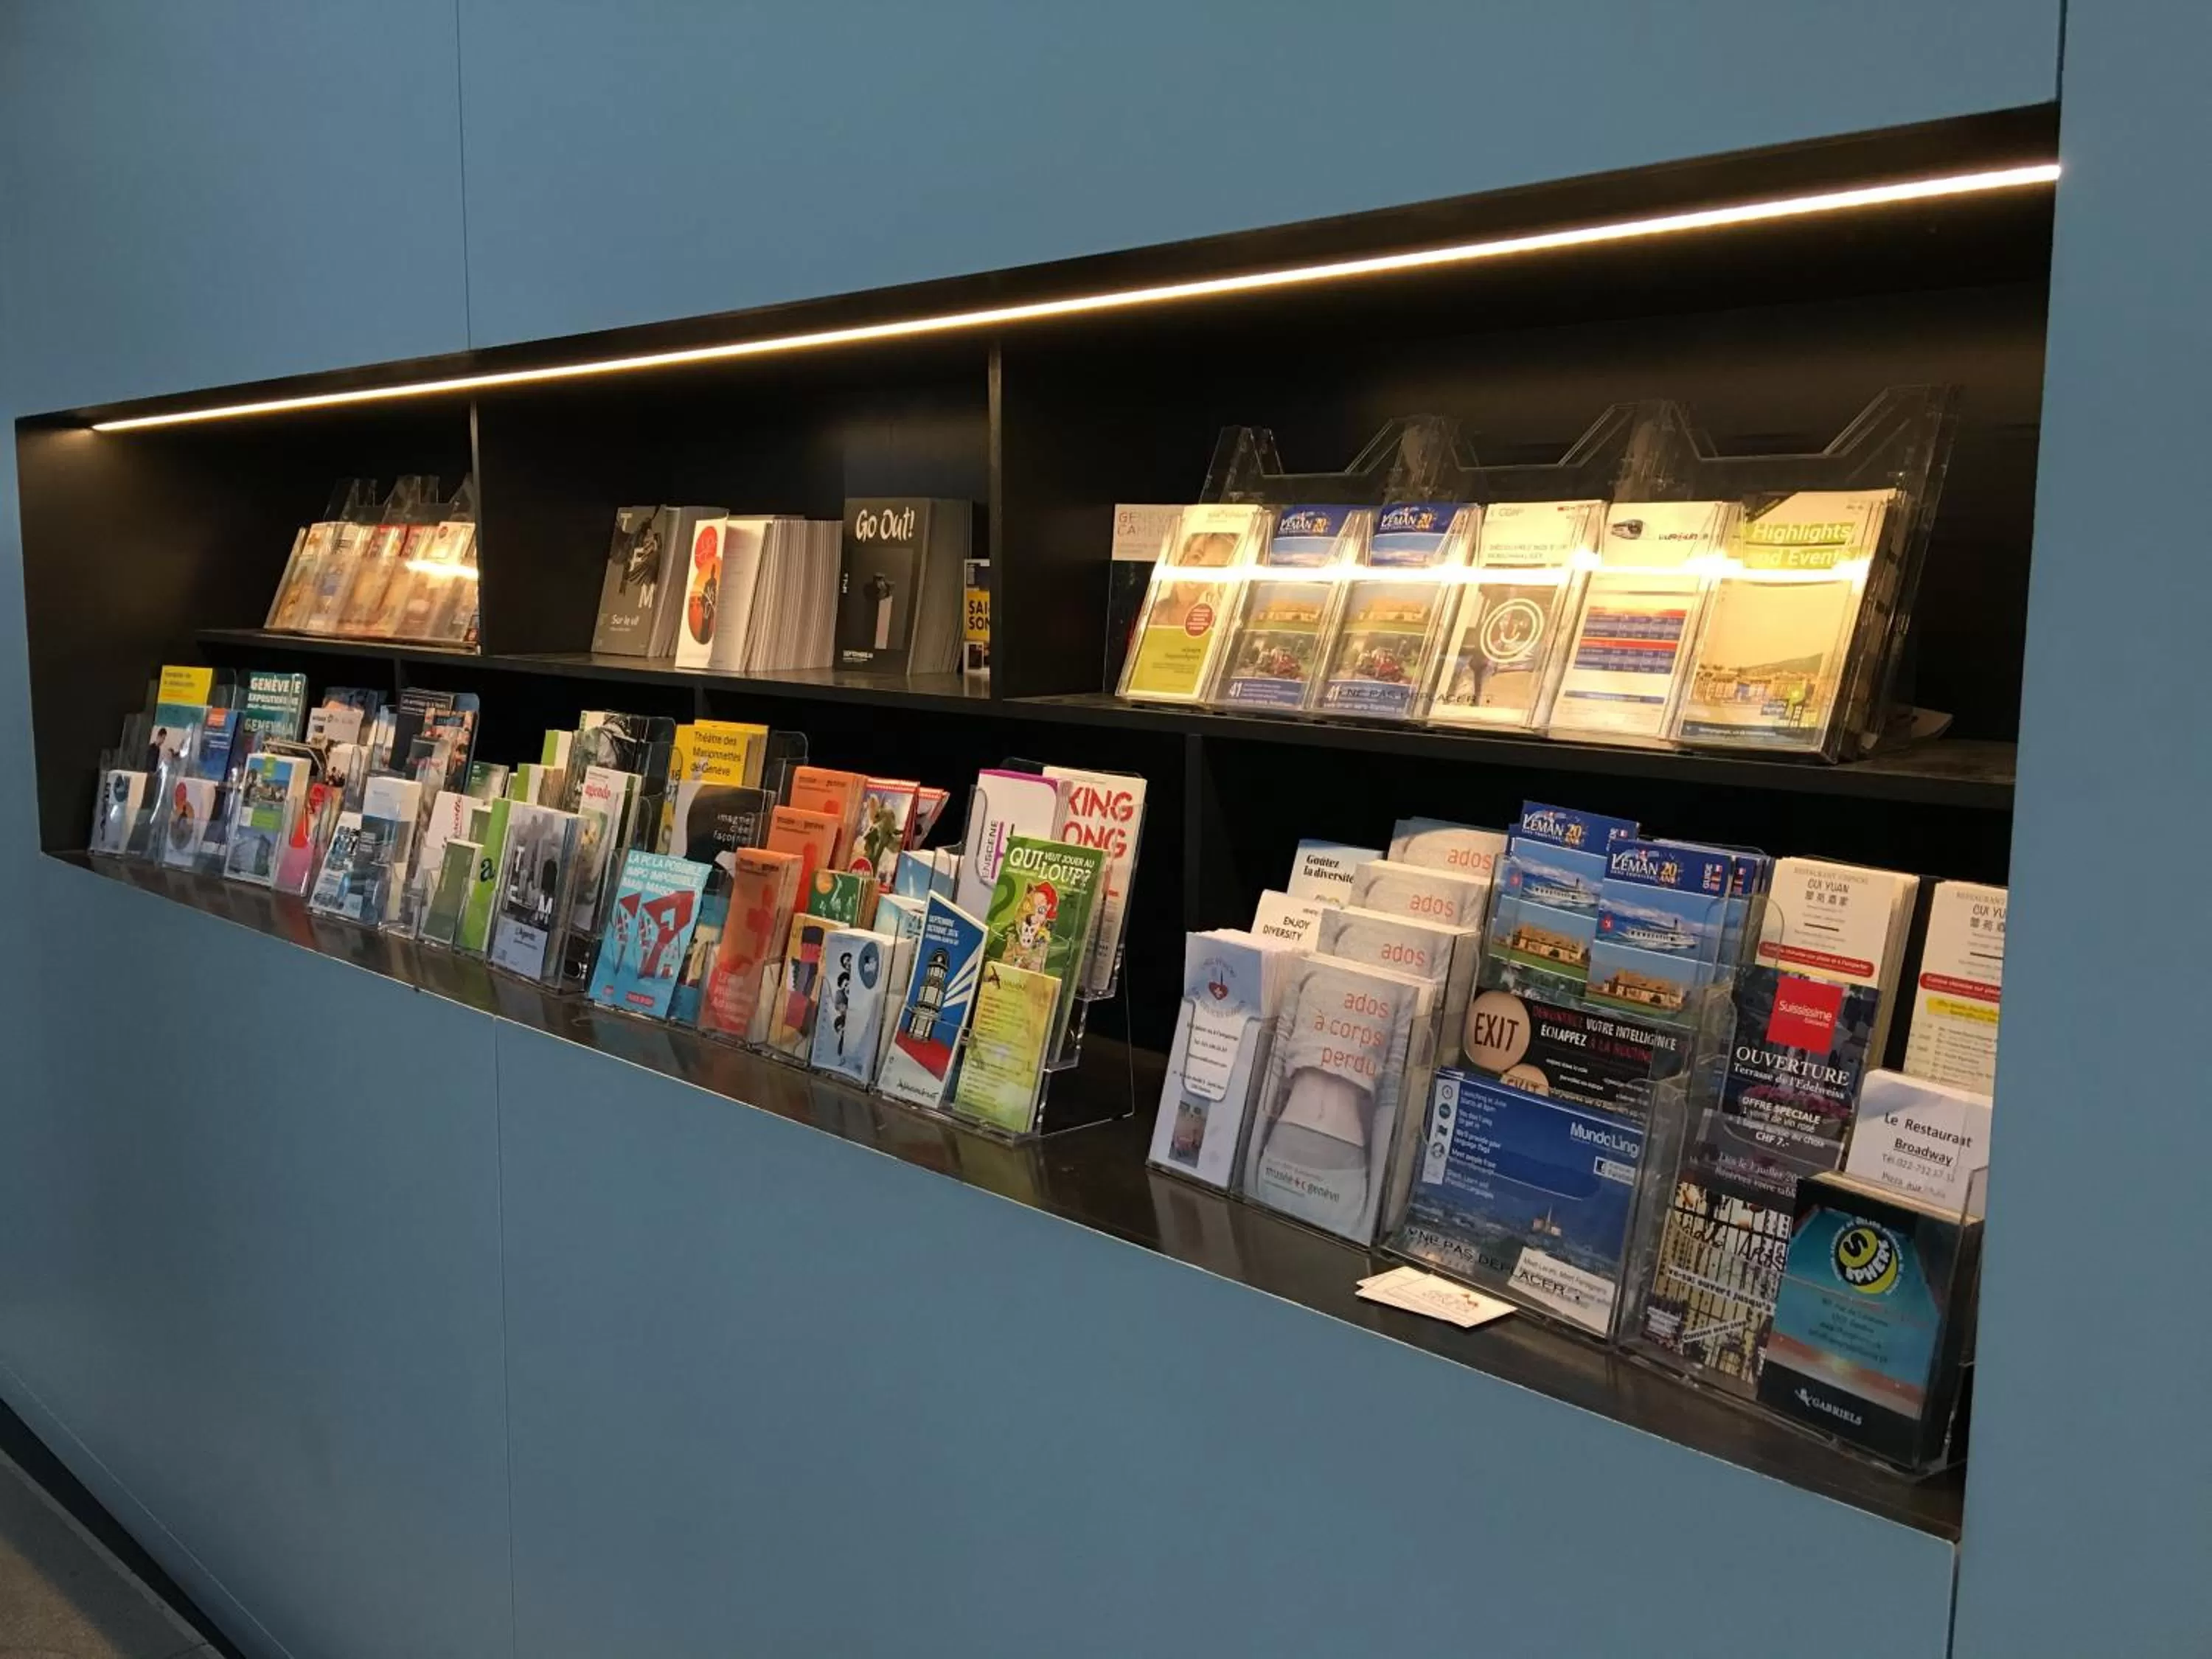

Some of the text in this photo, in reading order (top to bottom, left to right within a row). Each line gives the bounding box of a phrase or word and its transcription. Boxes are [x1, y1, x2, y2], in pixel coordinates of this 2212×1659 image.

[856, 507, 915, 542] Go Out!
[1752, 523, 1851, 543] Highlights
[968, 600, 990, 614] SAI
[1069, 786, 1134, 822] KING
[1062, 821, 1127, 859] ONG
[1009, 846, 1045, 871] QUI
[1303, 865, 1315, 877] la
[1447, 847, 1493, 870] ados
[1038, 860, 1092, 886] LOUP?
[1409, 892, 1455, 917] ados
[1992, 905, 2005, 919] YU
[1262, 924, 1304, 942] DIVERSITY
[1283, 916, 1311, 931] ENJOY
[1380, 942, 1426, 968] ados
[1344, 991, 1390, 1019] ados
[1314, 1009, 1385, 1047] à corps
[1474, 1012, 1520, 1052] EXIT
[1321, 1046, 1377, 1078] perdu
[1733, 1062, 1773, 1082] Terrasse
[1736, 1046, 1851, 1088] OUVERTURE
[1742, 1096, 1773, 1112] OFFRE
[1884, 1112, 1899, 1127] Le
[1756, 1132, 1775, 1144] CHF
[1893, 1137, 1954, 1166] Broadway
[1418, 1229, 1439, 1245] NE
[1442, 1240, 1473, 1263] PAS
[1843, 1232, 1868, 1257] S
